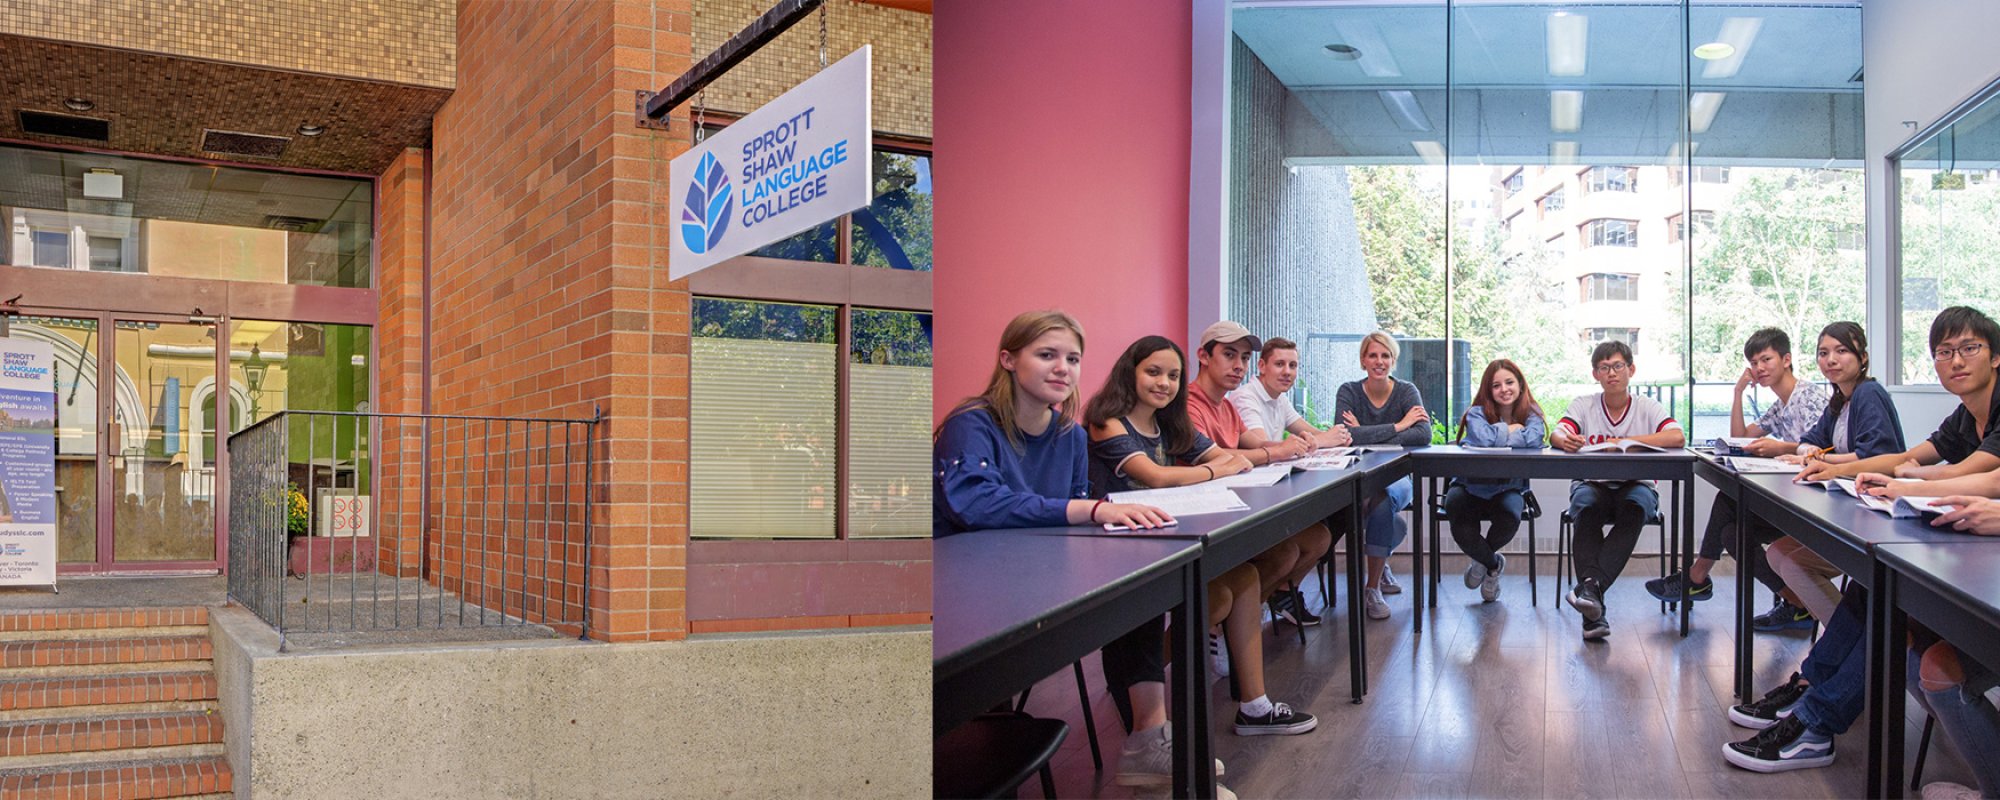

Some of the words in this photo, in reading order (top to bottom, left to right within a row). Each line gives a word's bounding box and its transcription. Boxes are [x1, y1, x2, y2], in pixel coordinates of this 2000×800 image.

[743, 106, 815, 162] SPROTT
[743, 141, 797, 184] SHAW
[742, 139, 848, 208] LANGUAGE
[742, 174, 827, 228] COLLEGE
[3, 352, 35, 360] SPROTT
[3, 358, 28, 366] SHAW
[3, 365, 48, 375] LANGUAGE
[3, 371, 41, 380] COLLEGE
[20, 403, 47, 411] awaits
